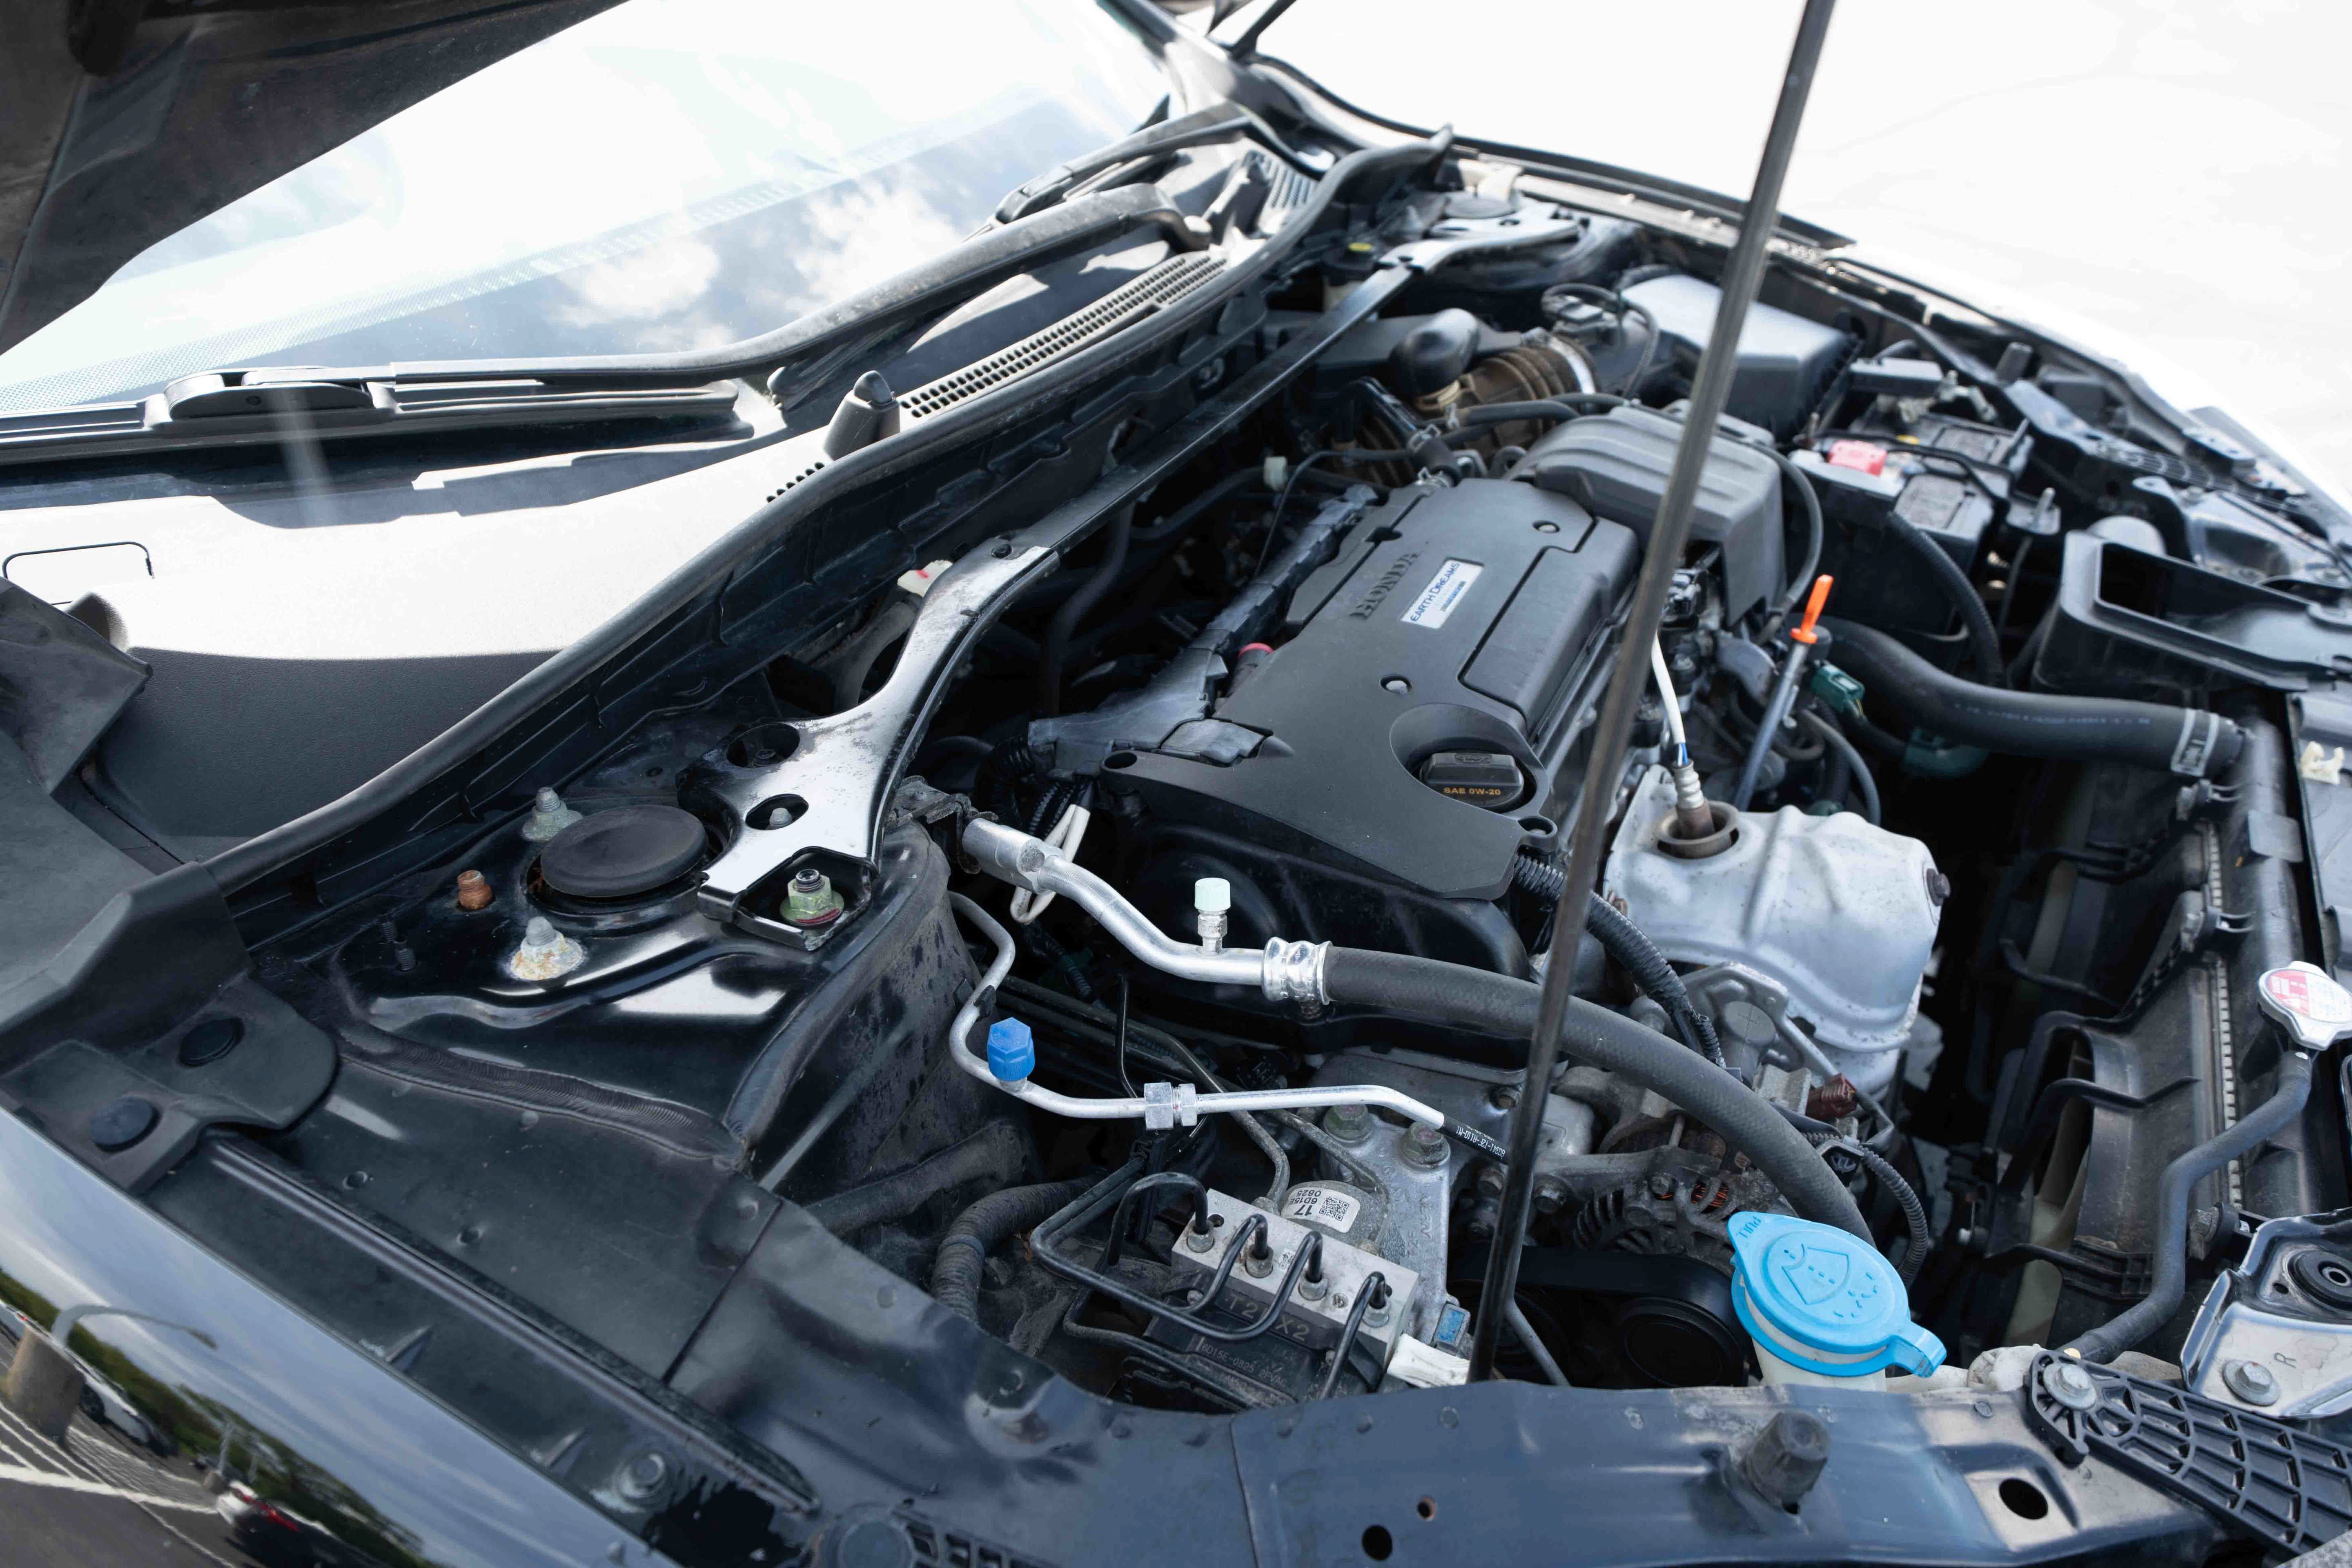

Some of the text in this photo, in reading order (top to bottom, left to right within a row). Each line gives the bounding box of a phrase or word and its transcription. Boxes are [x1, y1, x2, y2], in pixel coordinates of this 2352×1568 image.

[1349, 552, 1419, 620] HONDA
[1410, 595, 1436, 621] EARTH
[1288, 1197, 1318, 1205] 6D15E
[1294, 1204, 1312, 1216] 17
[1736, 1216, 1762, 1238] PULL
[2274, 1352, 2297, 1370] R
